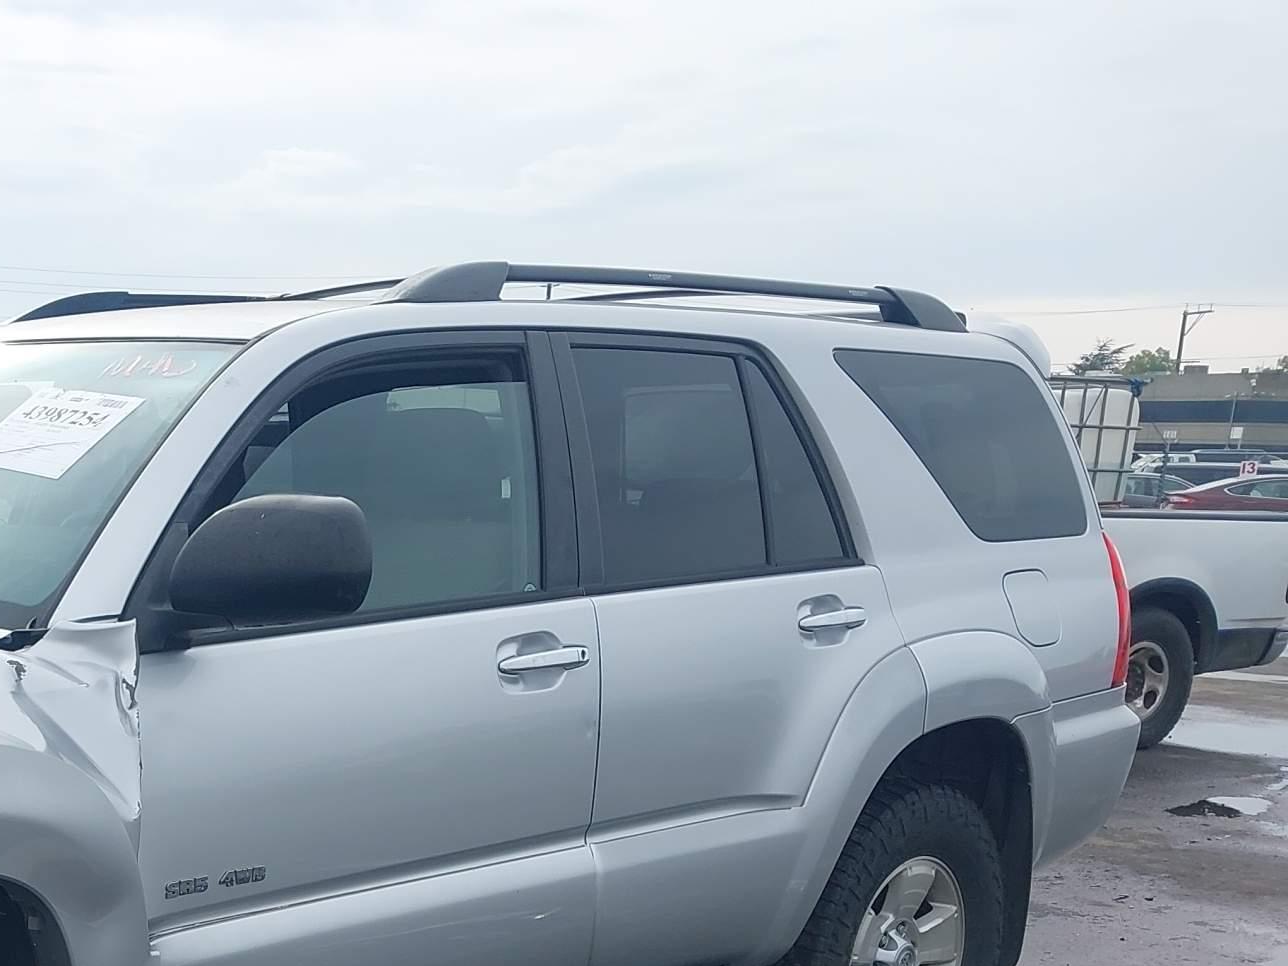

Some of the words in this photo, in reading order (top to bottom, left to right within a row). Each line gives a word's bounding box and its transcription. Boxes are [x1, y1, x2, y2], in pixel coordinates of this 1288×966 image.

[22, 404, 110, 428] 43987254
[1240, 462, 1256, 475] 13
[165, 875, 209, 900] SR5
[218, 865, 266, 887] 4WD
